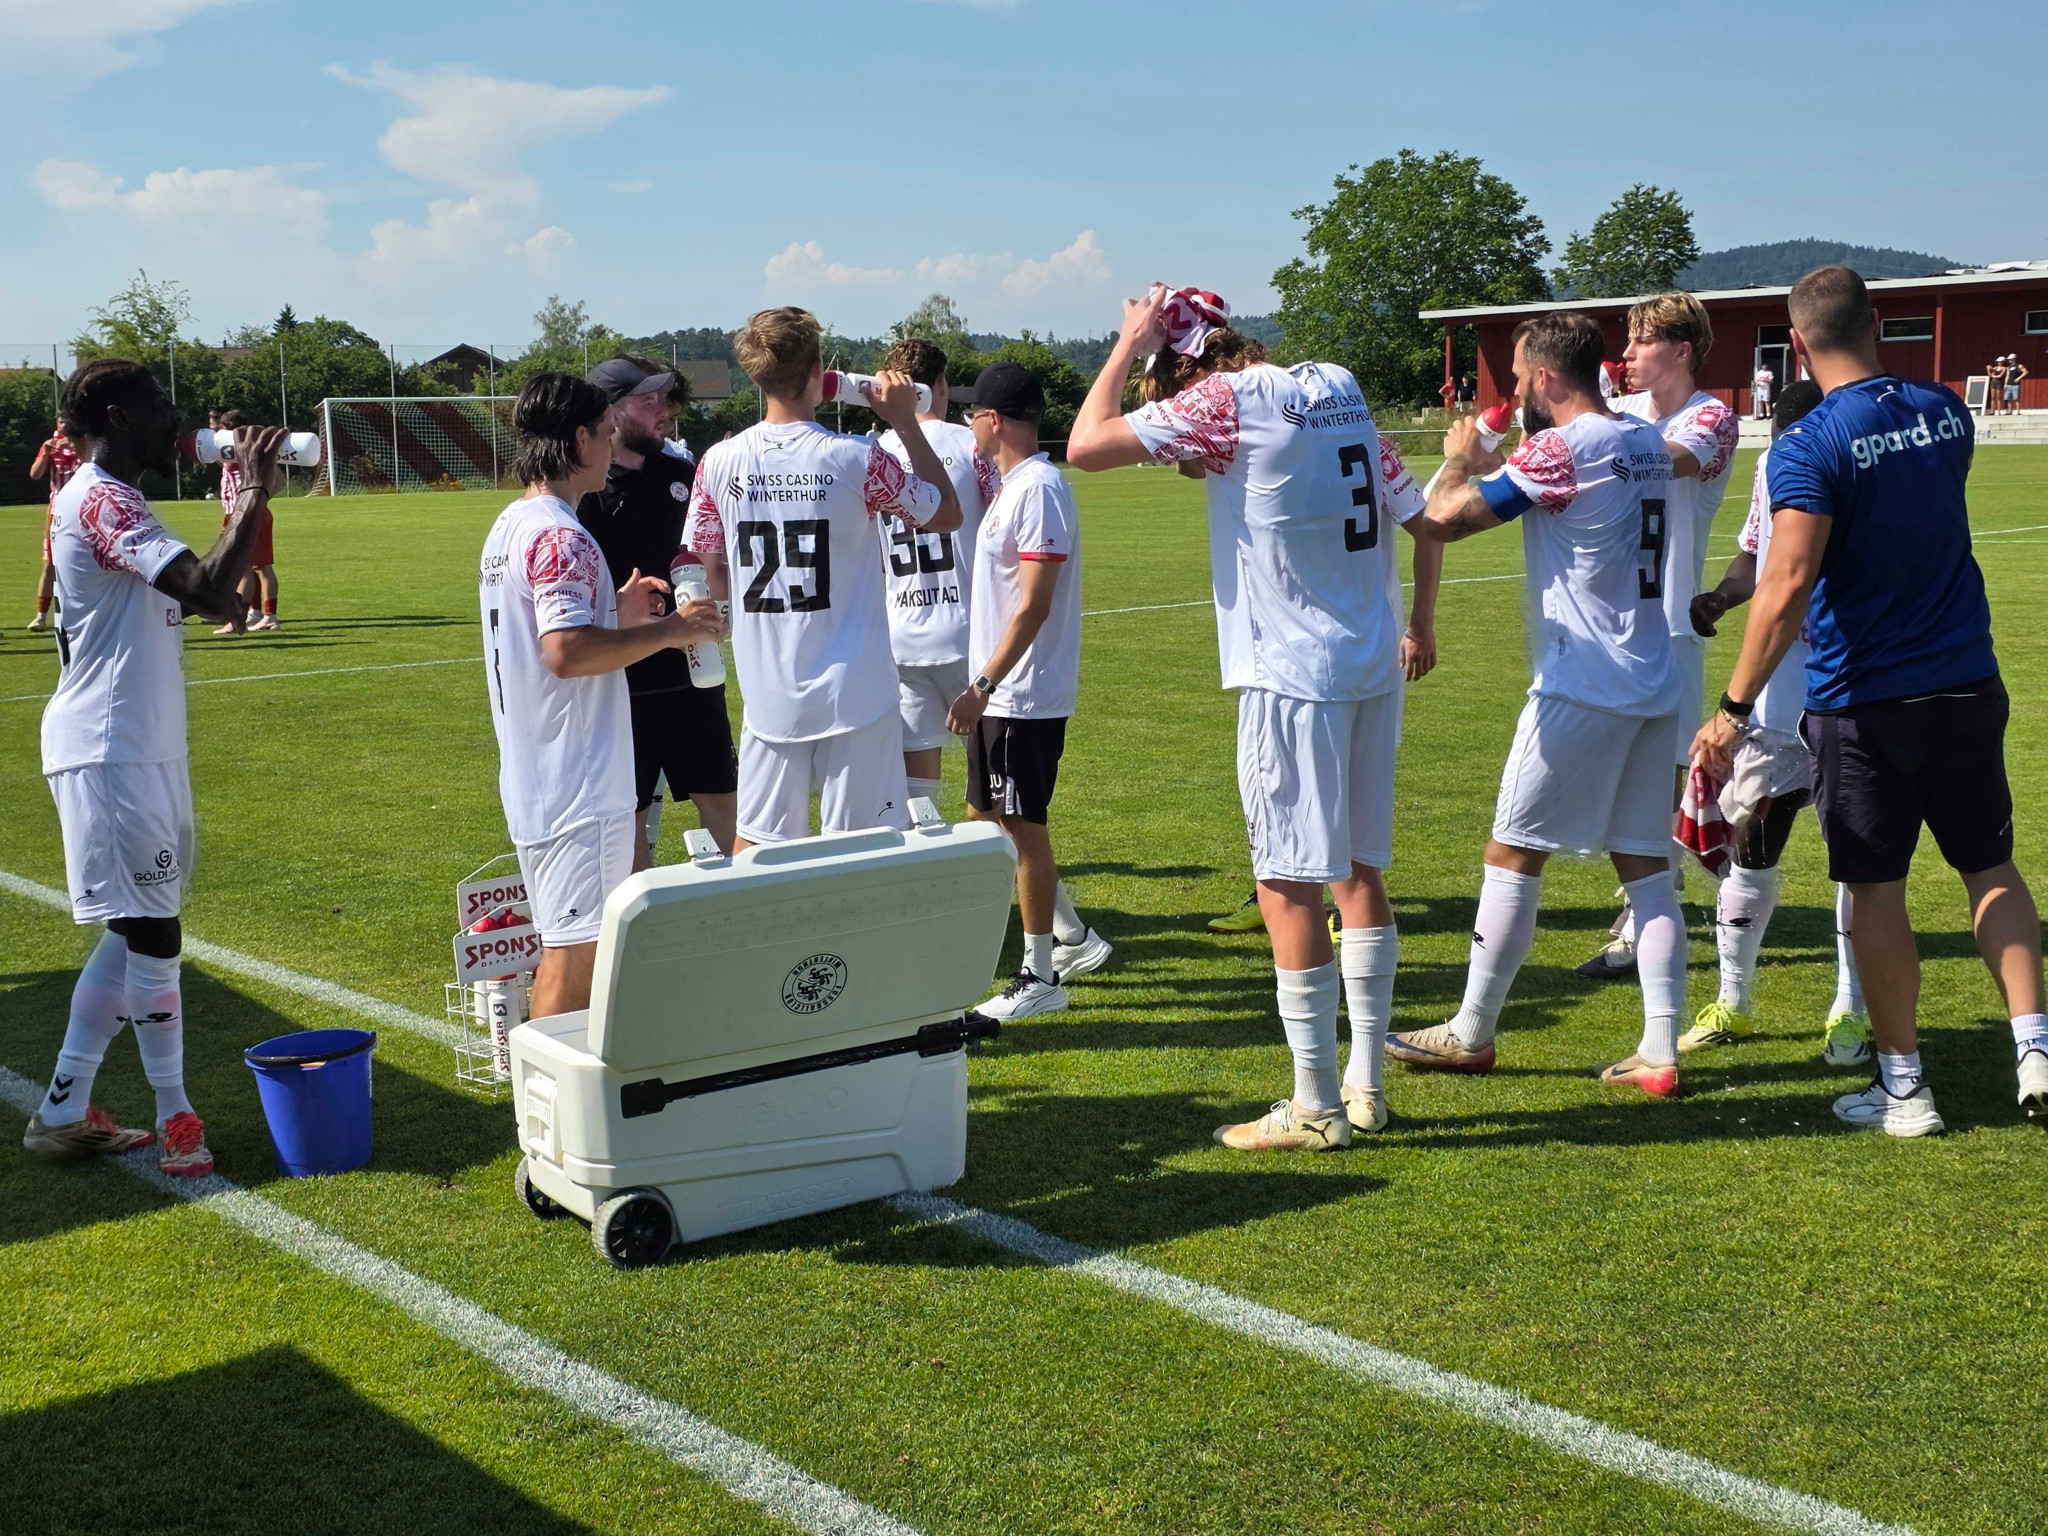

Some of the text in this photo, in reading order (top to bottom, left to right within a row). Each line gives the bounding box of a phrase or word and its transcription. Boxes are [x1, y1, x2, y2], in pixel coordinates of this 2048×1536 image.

[1304, 396, 1337, 412] SWISS
[1309, 410, 1370, 429] WINTERTHU
[1851, 406, 1965, 469] gpard.ch
[1630, 453, 1656, 465] SWISS
[786, 474, 834, 486] CASINO
[747, 490, 827, 502] WINTERTHUR
[1338, 443, 1378, 552] 3
[1638, 499, 1666, 599] 9
[738, 519, 830, 613] 29
[546, 590, 582, 600] SCHIESS
[465, 934, 542, 969] SPONS
[793, 956, 842, 976] WINTERTHUR
[785, 986, 842, 1012] FUSSBALLCLUB
[728, 1176, 856, 1224] MAXCOLD
